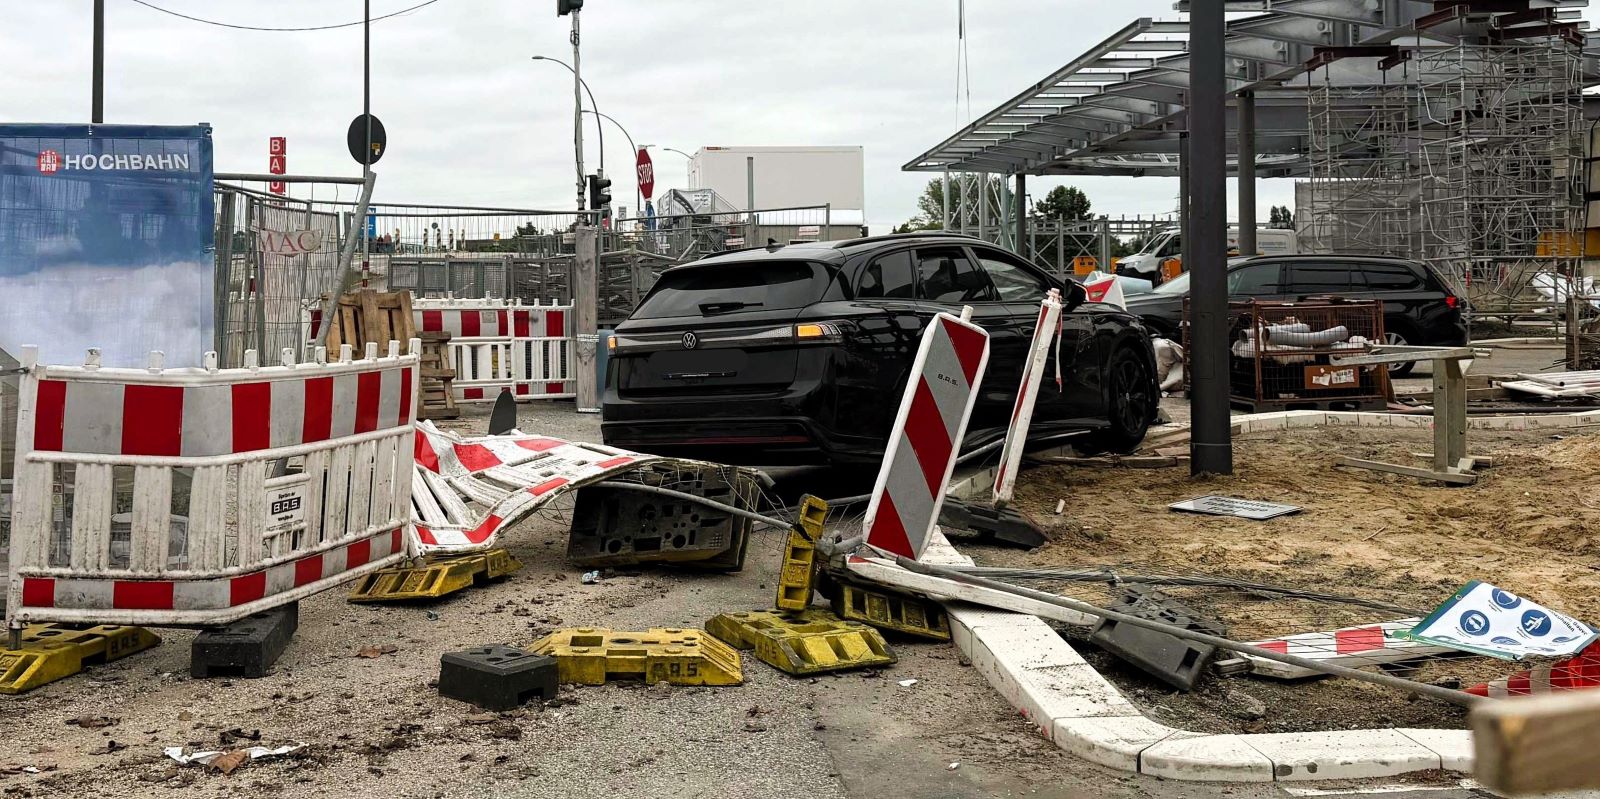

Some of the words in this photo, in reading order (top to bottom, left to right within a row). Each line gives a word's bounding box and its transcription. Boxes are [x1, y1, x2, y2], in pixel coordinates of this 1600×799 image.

[65, 153, 189, 170] HOCHBAHN
[638, 163, 652, 185] STOP
[273, 499, 300, 513] B.A.S.
